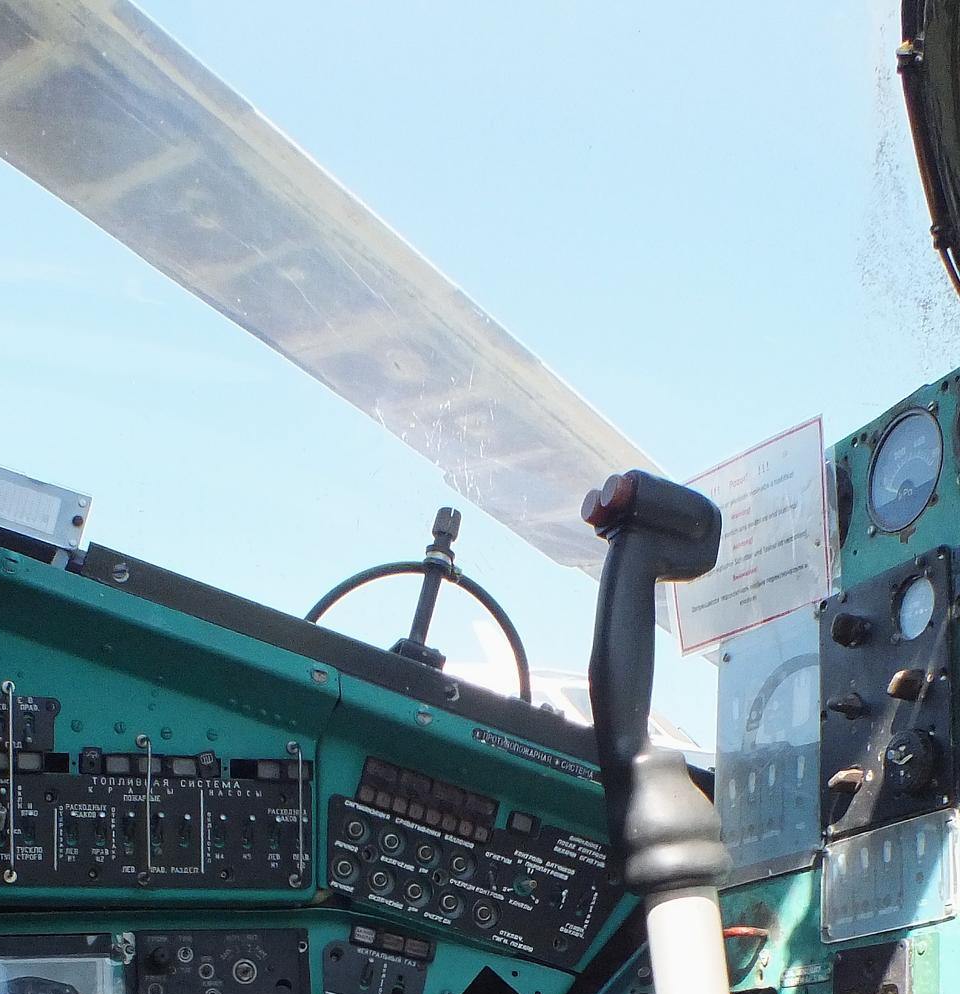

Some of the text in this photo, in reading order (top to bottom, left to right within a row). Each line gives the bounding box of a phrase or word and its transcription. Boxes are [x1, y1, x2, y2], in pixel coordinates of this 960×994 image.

[483, 731, 593, 779] ПРОТИВОПОЖАРНАЯ СИСТЕМА
[180, 779, 241, 789] СИСТЕМА
[209, 789, 262, 797] НАСОСЫ
[123, 794, 161, 802] ПОЖАРЫЕ
